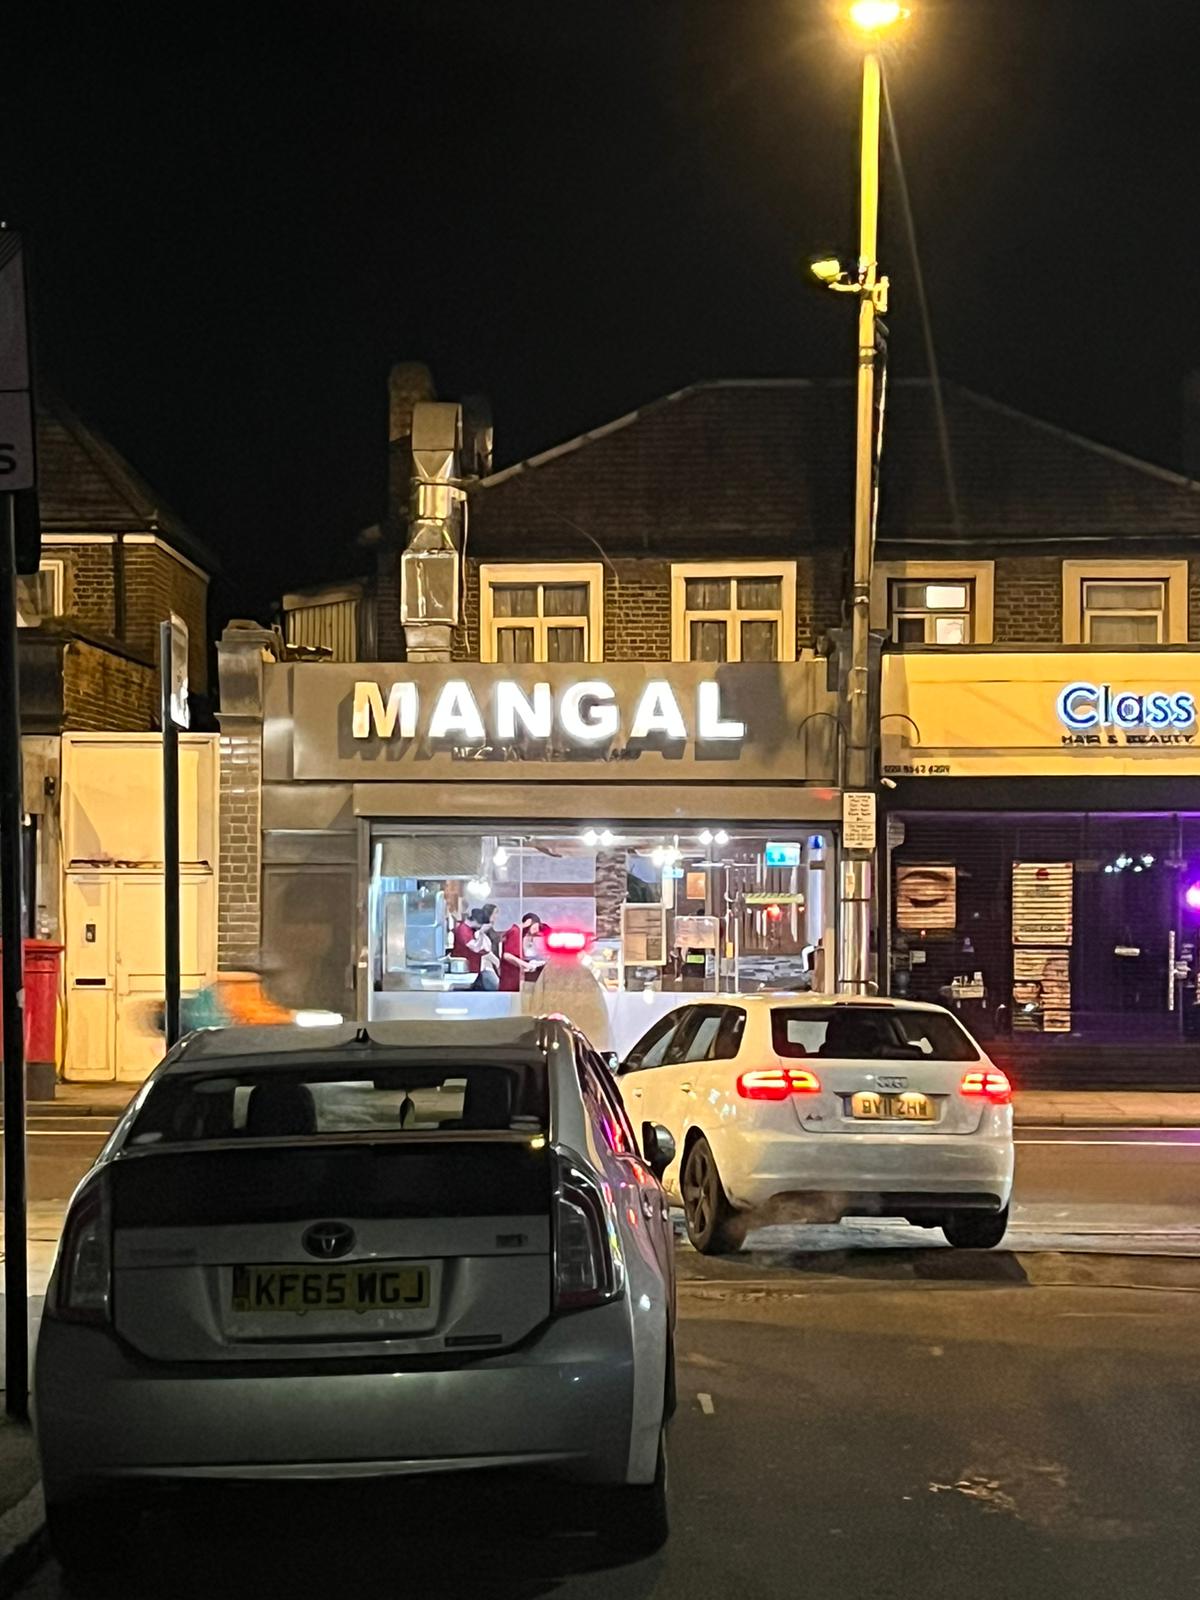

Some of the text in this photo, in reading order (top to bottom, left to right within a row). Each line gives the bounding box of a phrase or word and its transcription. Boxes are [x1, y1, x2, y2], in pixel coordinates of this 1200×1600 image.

[351, 680, 746, 739] MANGAL
[1058, 682, 1196, 729] Class
[1061, 734, 1195, 744] HAIR & BEAUTY
[255, 1272, 347, 1306] KF65
